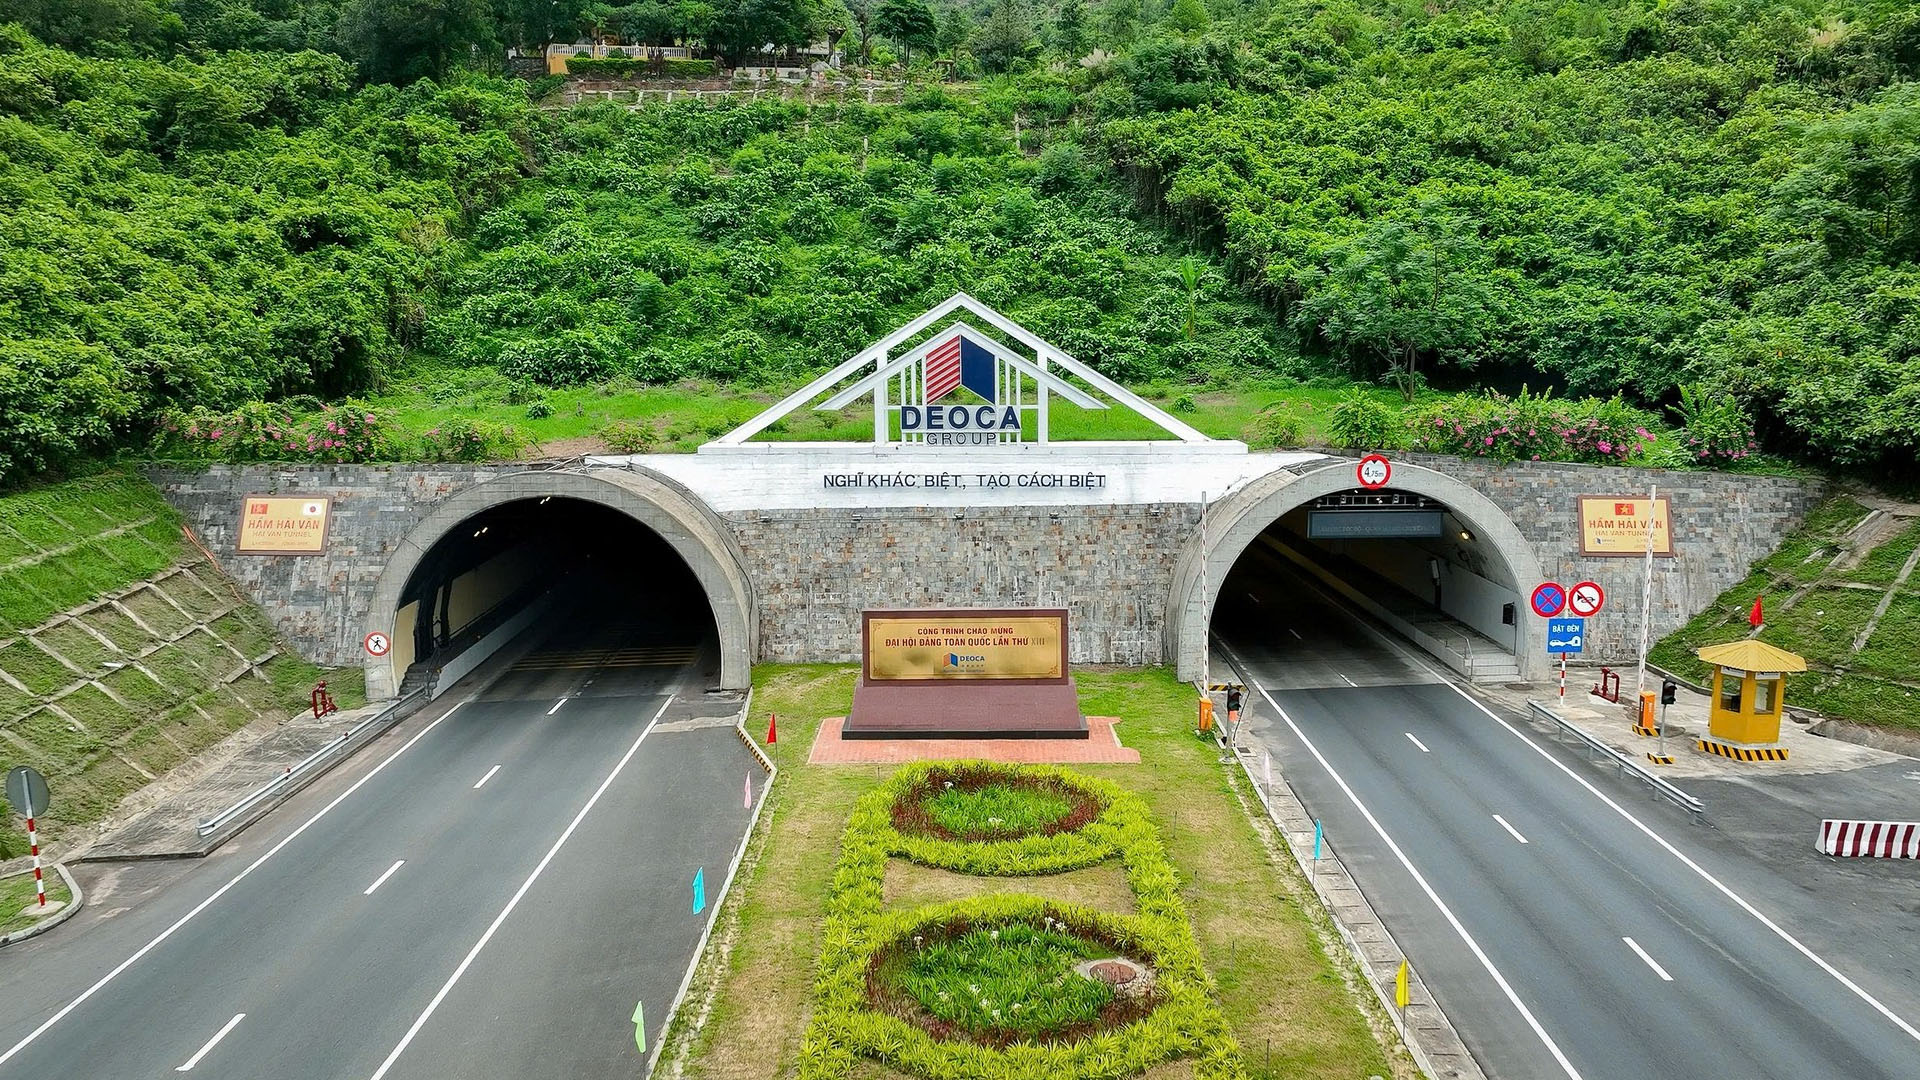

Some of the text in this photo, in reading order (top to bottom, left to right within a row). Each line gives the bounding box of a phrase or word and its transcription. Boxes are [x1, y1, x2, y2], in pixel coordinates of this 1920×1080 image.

[901, 406, 1021, 430] DEOCA
[926, 432, 996, 445] GROUP
[823, 471, 1106, 490] NGHĨ KHÁC BIỆT, TẠO CÁCH BIỆT
[1640, 519, 1663, 529] VN
[1552, 624, 1565, 633] BẬT
[885, 638, 900, 648] ĐẠI
[902, 636, 917, 648] HỘI
[967, 635, 991, 646] QUỐC
[1012, 636, 1029, 646] THỨ
